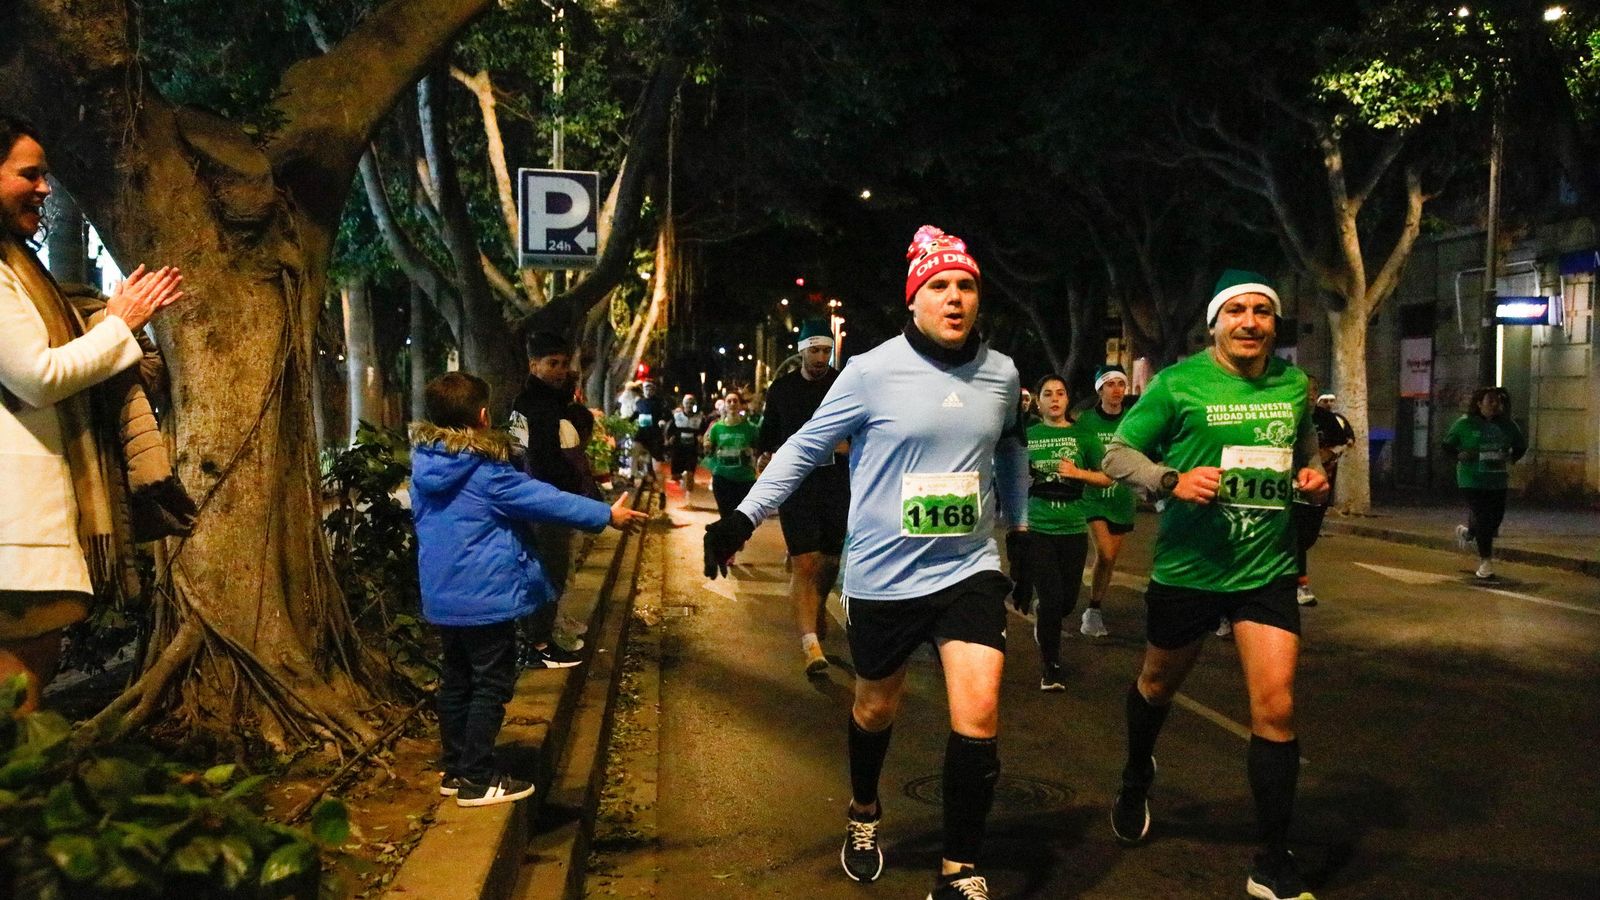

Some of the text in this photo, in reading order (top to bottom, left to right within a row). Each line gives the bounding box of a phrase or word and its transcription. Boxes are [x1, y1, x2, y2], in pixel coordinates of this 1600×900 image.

[528, 175, 591, 251] P
[548, 240, 572, 252] 24h
[916, 256, 939, 277] OH
[1206, 402, 1293, 414] XVII SAN SILVESTRE
[1206, 413, 1243, 422] CIUDAD
[1225, 476, 1289, 500] 1169
[907, 505, 975, 527] 1168
